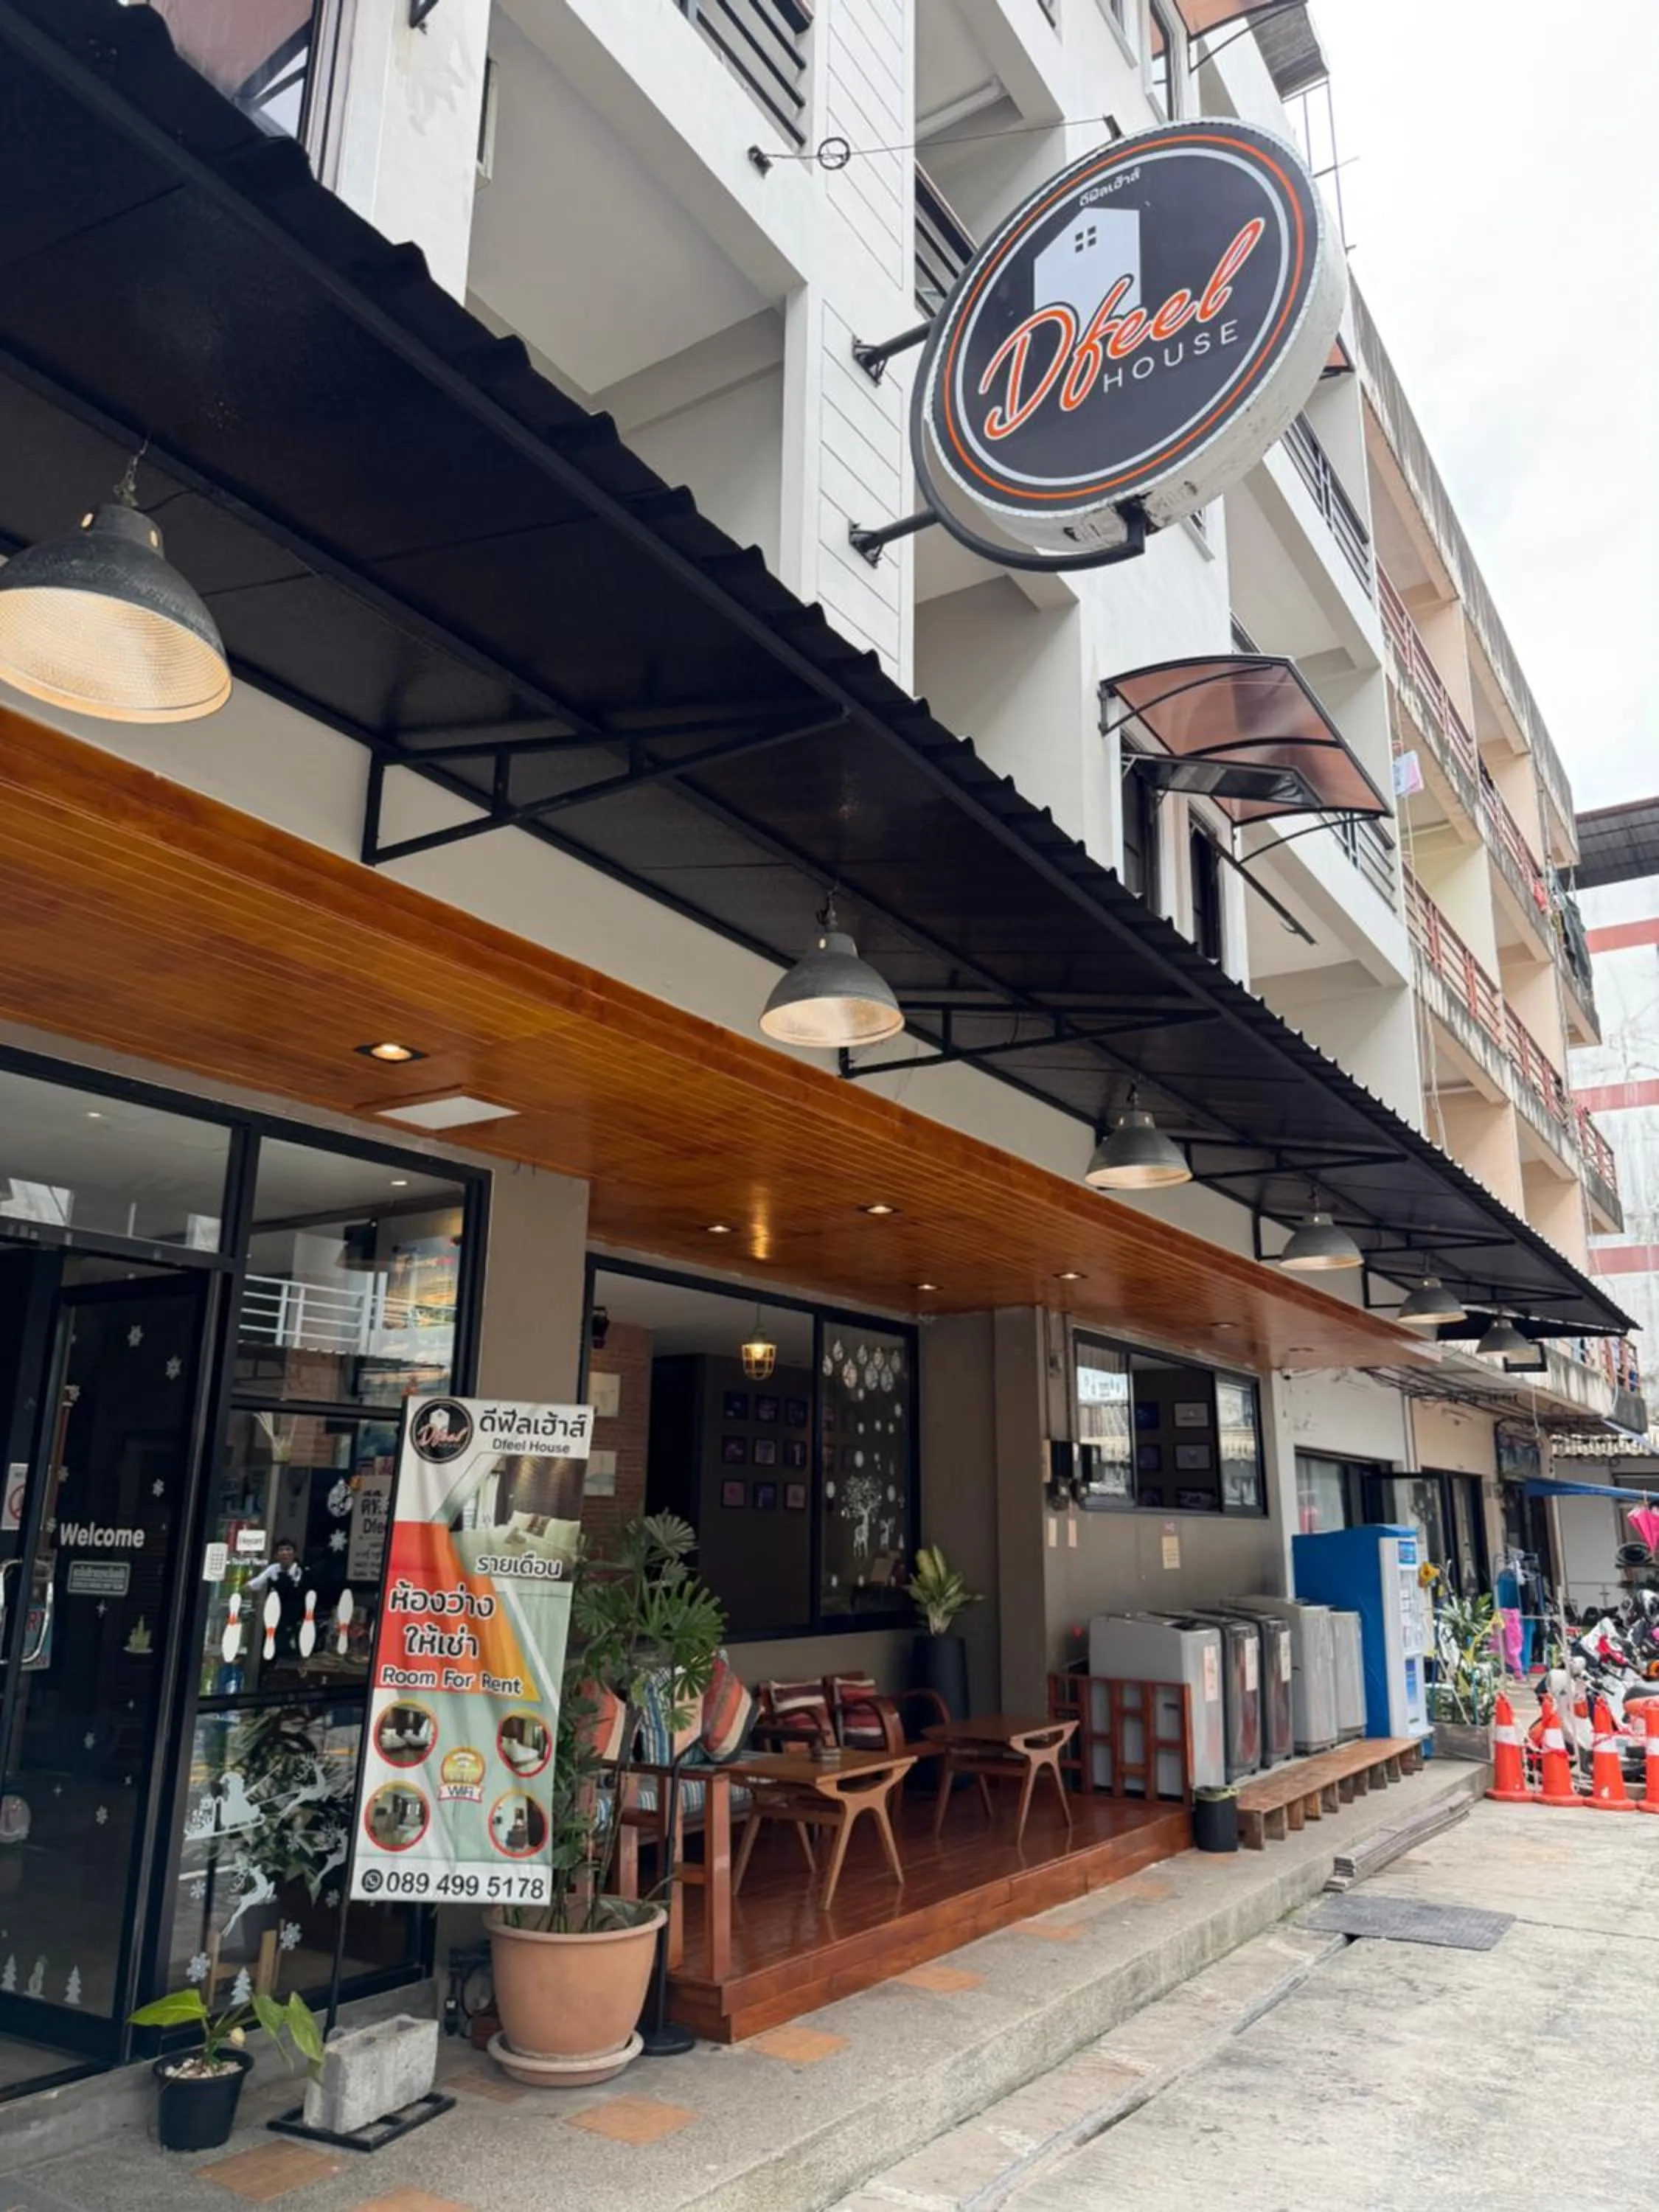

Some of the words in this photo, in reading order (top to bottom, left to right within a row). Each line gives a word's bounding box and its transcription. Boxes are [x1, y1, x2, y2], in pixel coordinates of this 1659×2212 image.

[978, 217, 1265, 440] Dfeel
[1102, 319, 1239, 393] HOUSE
[479, 1407, 588, 1438] ดีฟีลเฮ้าส์
[492, 1439, 526, 1451] Dfeel
[529, 1439, 571, 1454] House
[60, 1521, 145, 1548] Welcome
[477, 1552, 562, 1576] รายเดือน
[389, 1582, 495, 1617] ห้องว่าง
[405, 1624, 479, 1658] ให้เช่า
[382, 1666, 437, 1687] Room
[443, 1669, 475, 1688] For
[481, 1673, 523, 1695] Rent
[386, 1871, 431, 1894] 089
[437, 1874, 479, 1897] 499
[487, 1876, 544, 1900] 5178
